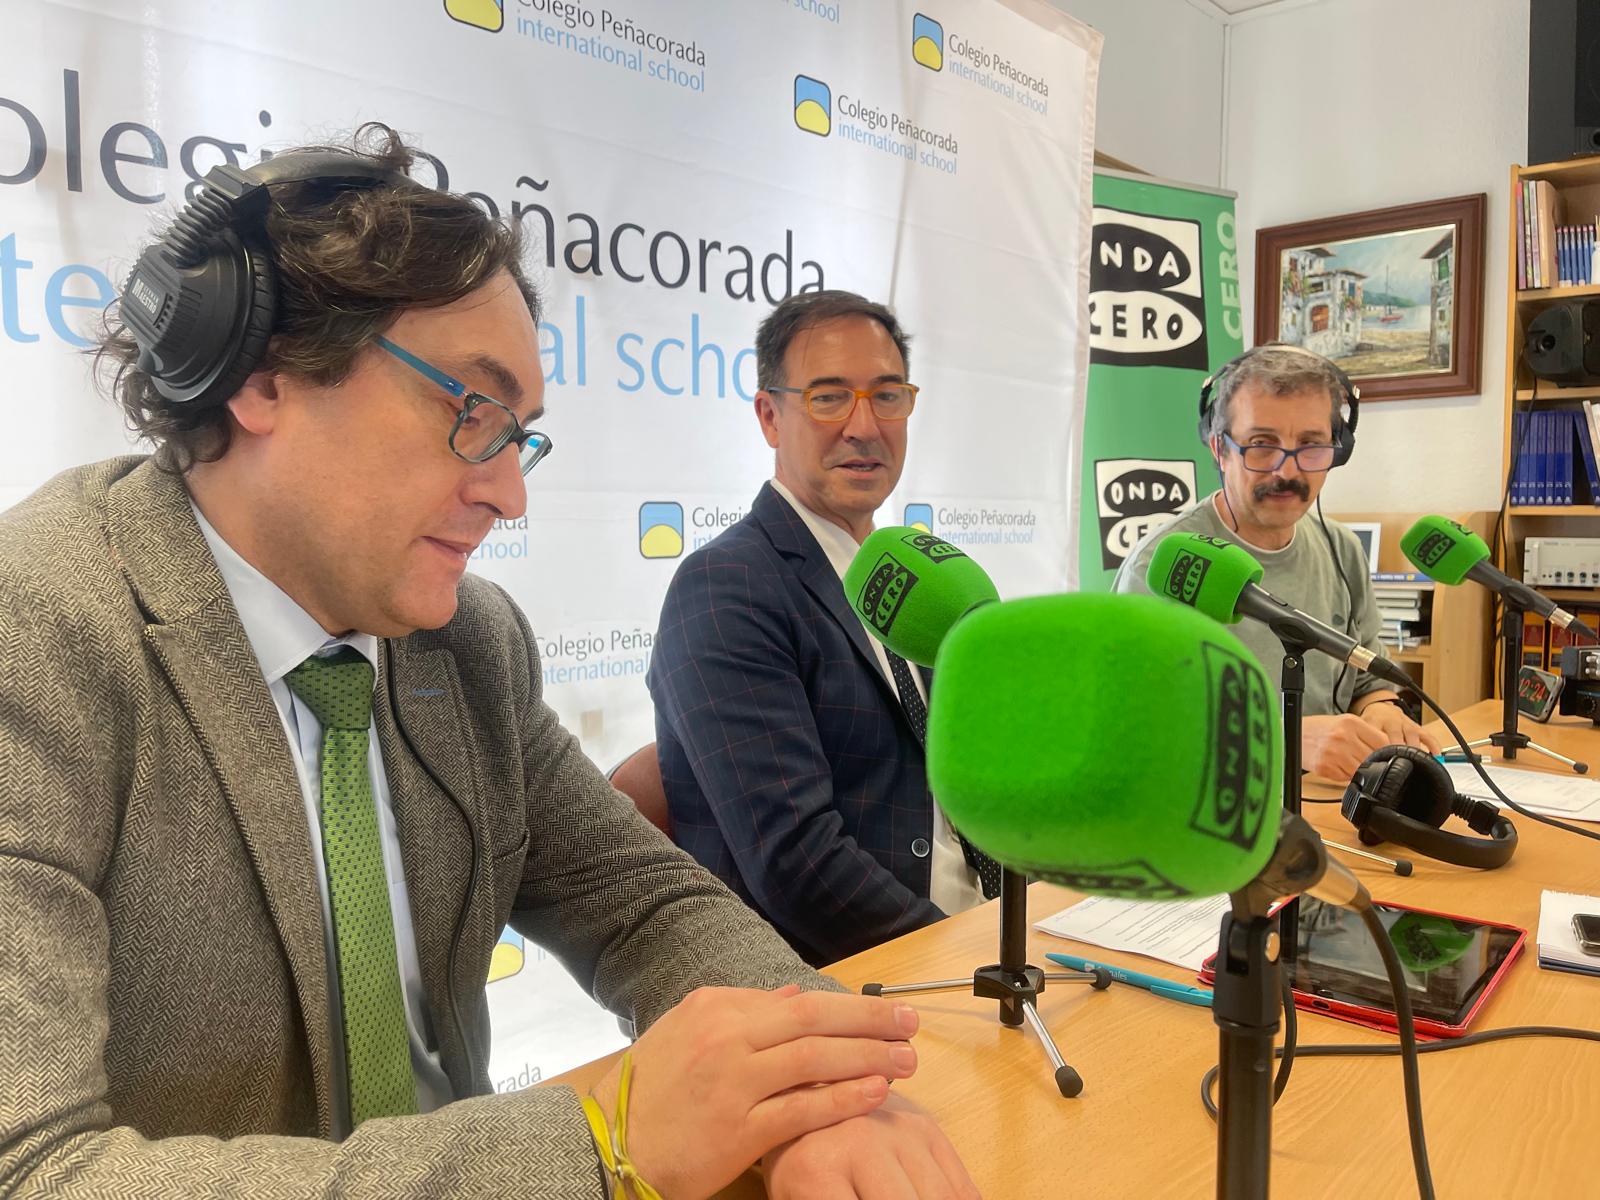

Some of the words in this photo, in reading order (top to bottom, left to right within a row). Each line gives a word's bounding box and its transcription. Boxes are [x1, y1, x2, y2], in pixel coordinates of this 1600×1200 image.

[517, 8, 642, 72] international
[648, 59, 705, 93] school
[602, 9, 706, 67] Peñacorada
[948, 34, 990, 69] Colegio
[992, 53, 1049, 97] Peñacorada
[949, 55, 1015, 99] international
[1016, 90, 1048, 116] school
[838, 95, 888, 130] Colegio
[891, 112, 958, 154] Peñacorada
[838, 117, 917, 162] international
[919, 146, 957, 175] school
[420, 150, 825, 307] ñacorada
[1099, 240, 1180, 278] NDA
[1216, 211, 1243, 340] CERO
[616, 313, 757, 402] scho
[1111, 482, 1183, 505] ONDA
[938, 507, 979, 530] Colegio
[980, 508, 1036, 526] Peñacorada
[1004, 528, 1033, 544] school
[1119, 524, 1148, 548] CE
[864, 569, 891, 610] ONDA
[1171, 558, 1189, 591] ONDA
[1183, 563, 1202, 596] CERO
[877, 577, 904, 620] CERO
[543, 651, 649, 685] nternational
[1519, 678, 1546, 702] 12:24
[1218, 678, 1243, 812] ONDA
